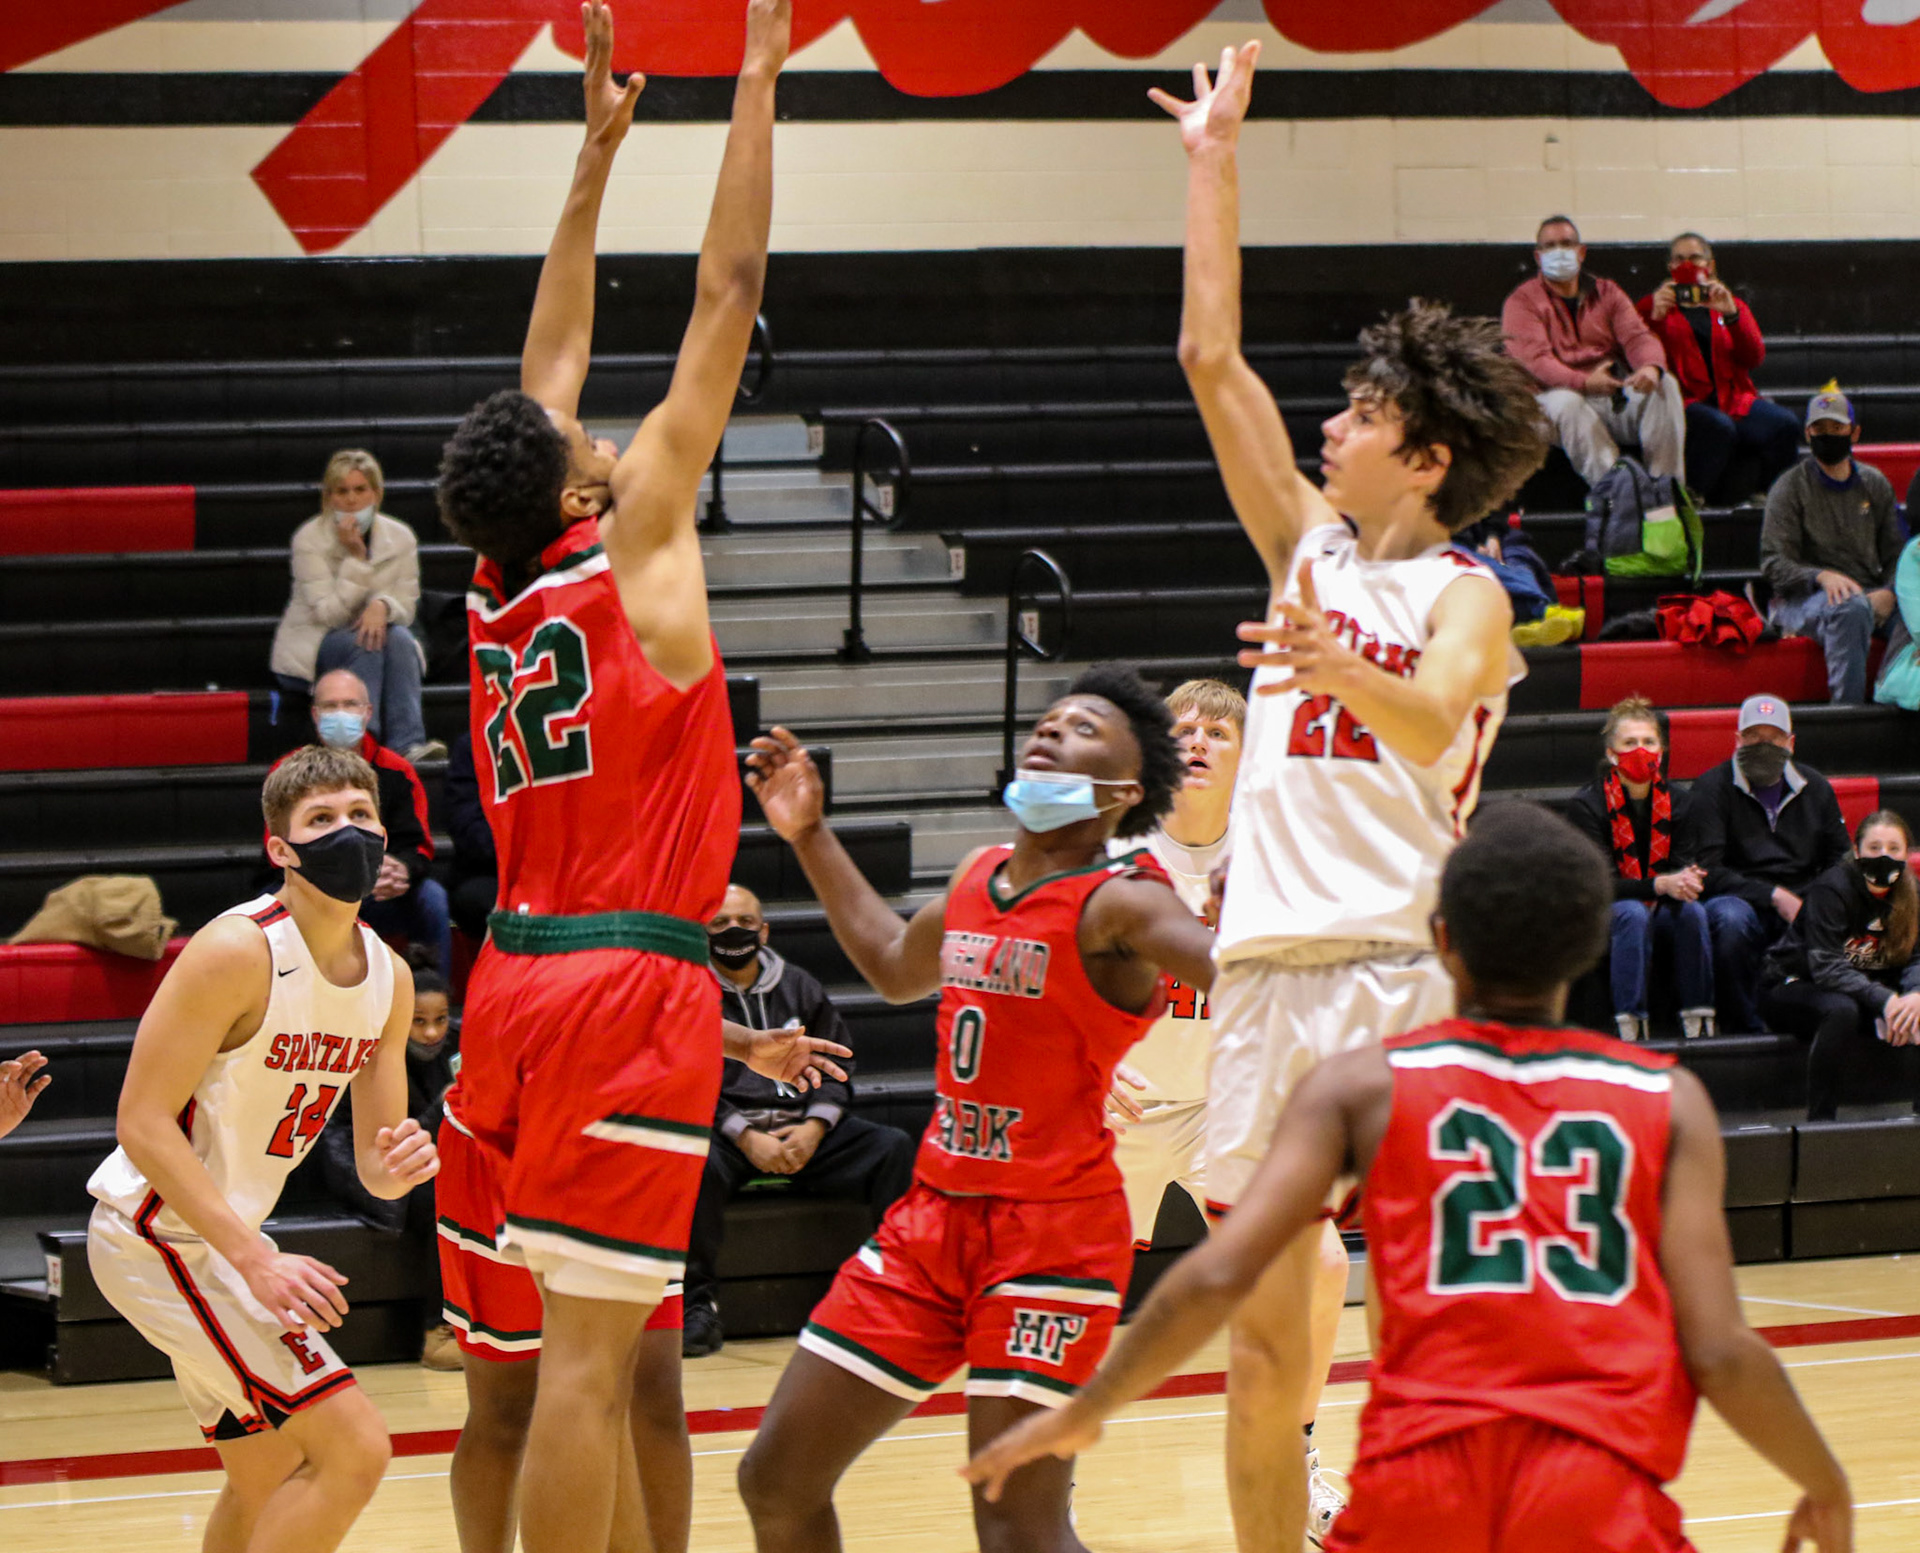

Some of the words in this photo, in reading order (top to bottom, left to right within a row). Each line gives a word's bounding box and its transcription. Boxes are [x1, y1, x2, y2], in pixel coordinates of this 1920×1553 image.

[473, 616, 593, 804] 22
[941, 930, 1050, 999] IGHLAND
[952, 1005, 986, 1084] 0
[265, 1083, 340, 1158] 24
[930, 1093, 1022, 1163] ARK
[1427, 1097, 1638, 1307] 23
[279, 1331, 326, 1376] E
[1006, 1307, 1088, 1367] HP
